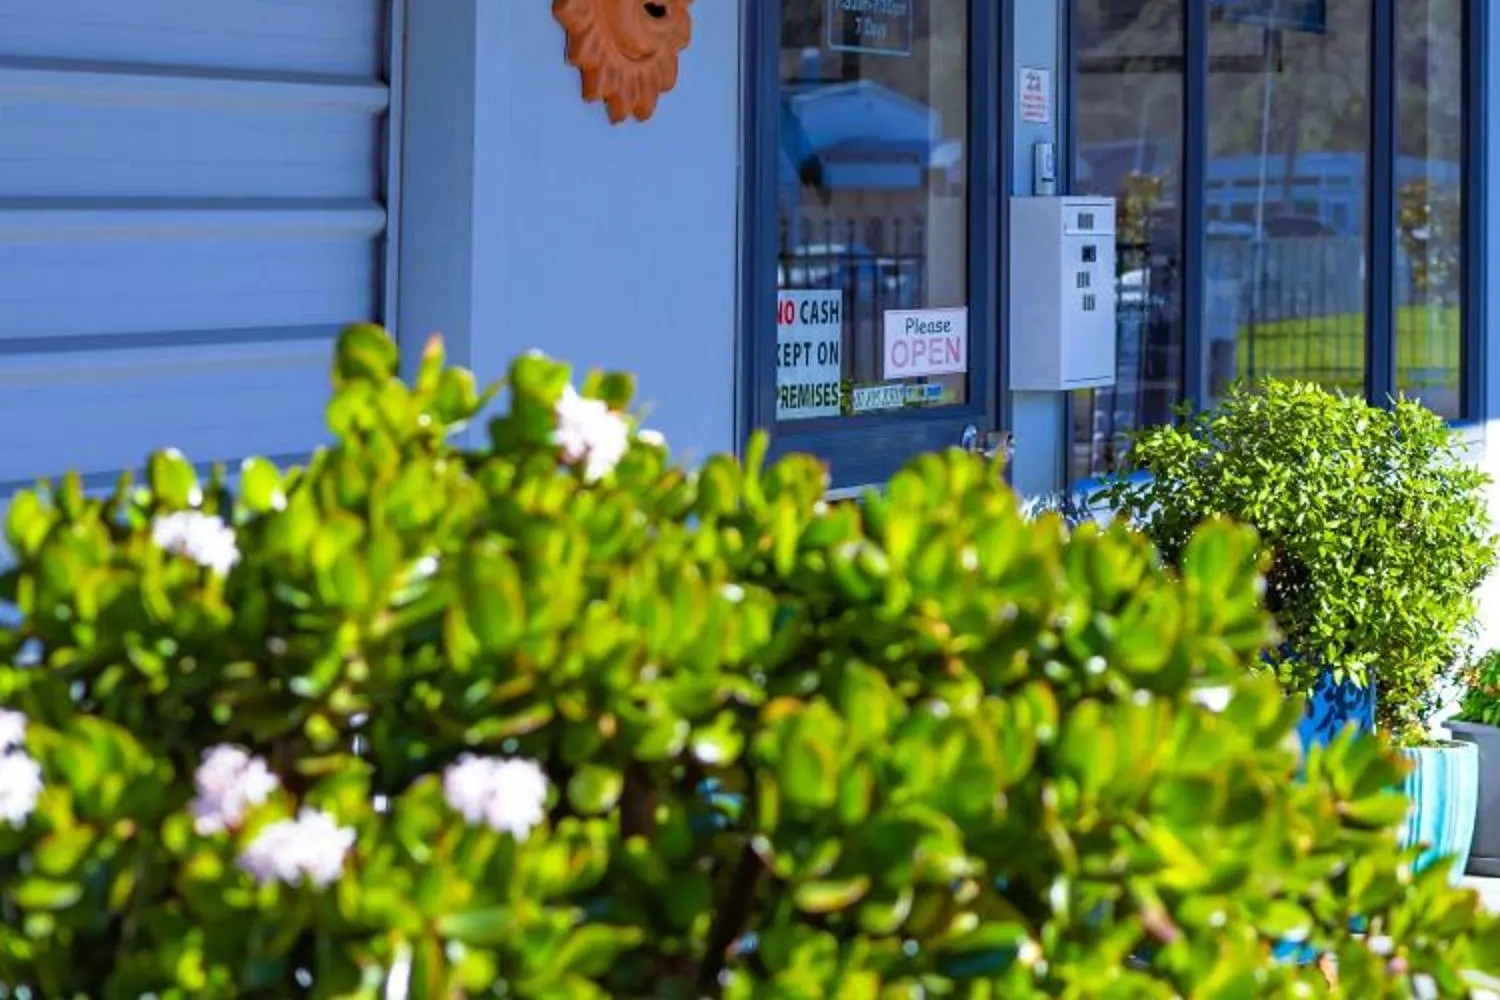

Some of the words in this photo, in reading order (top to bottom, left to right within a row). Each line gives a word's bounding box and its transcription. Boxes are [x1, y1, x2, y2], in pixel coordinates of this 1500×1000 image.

[799, 299, 839, 325] CASH
[905, 317, 951, 336] Please
[817, 341, 839, 366] ON
[891, 336, 961, 368] OPEN
[777, 382, 839, 410] REMISES
